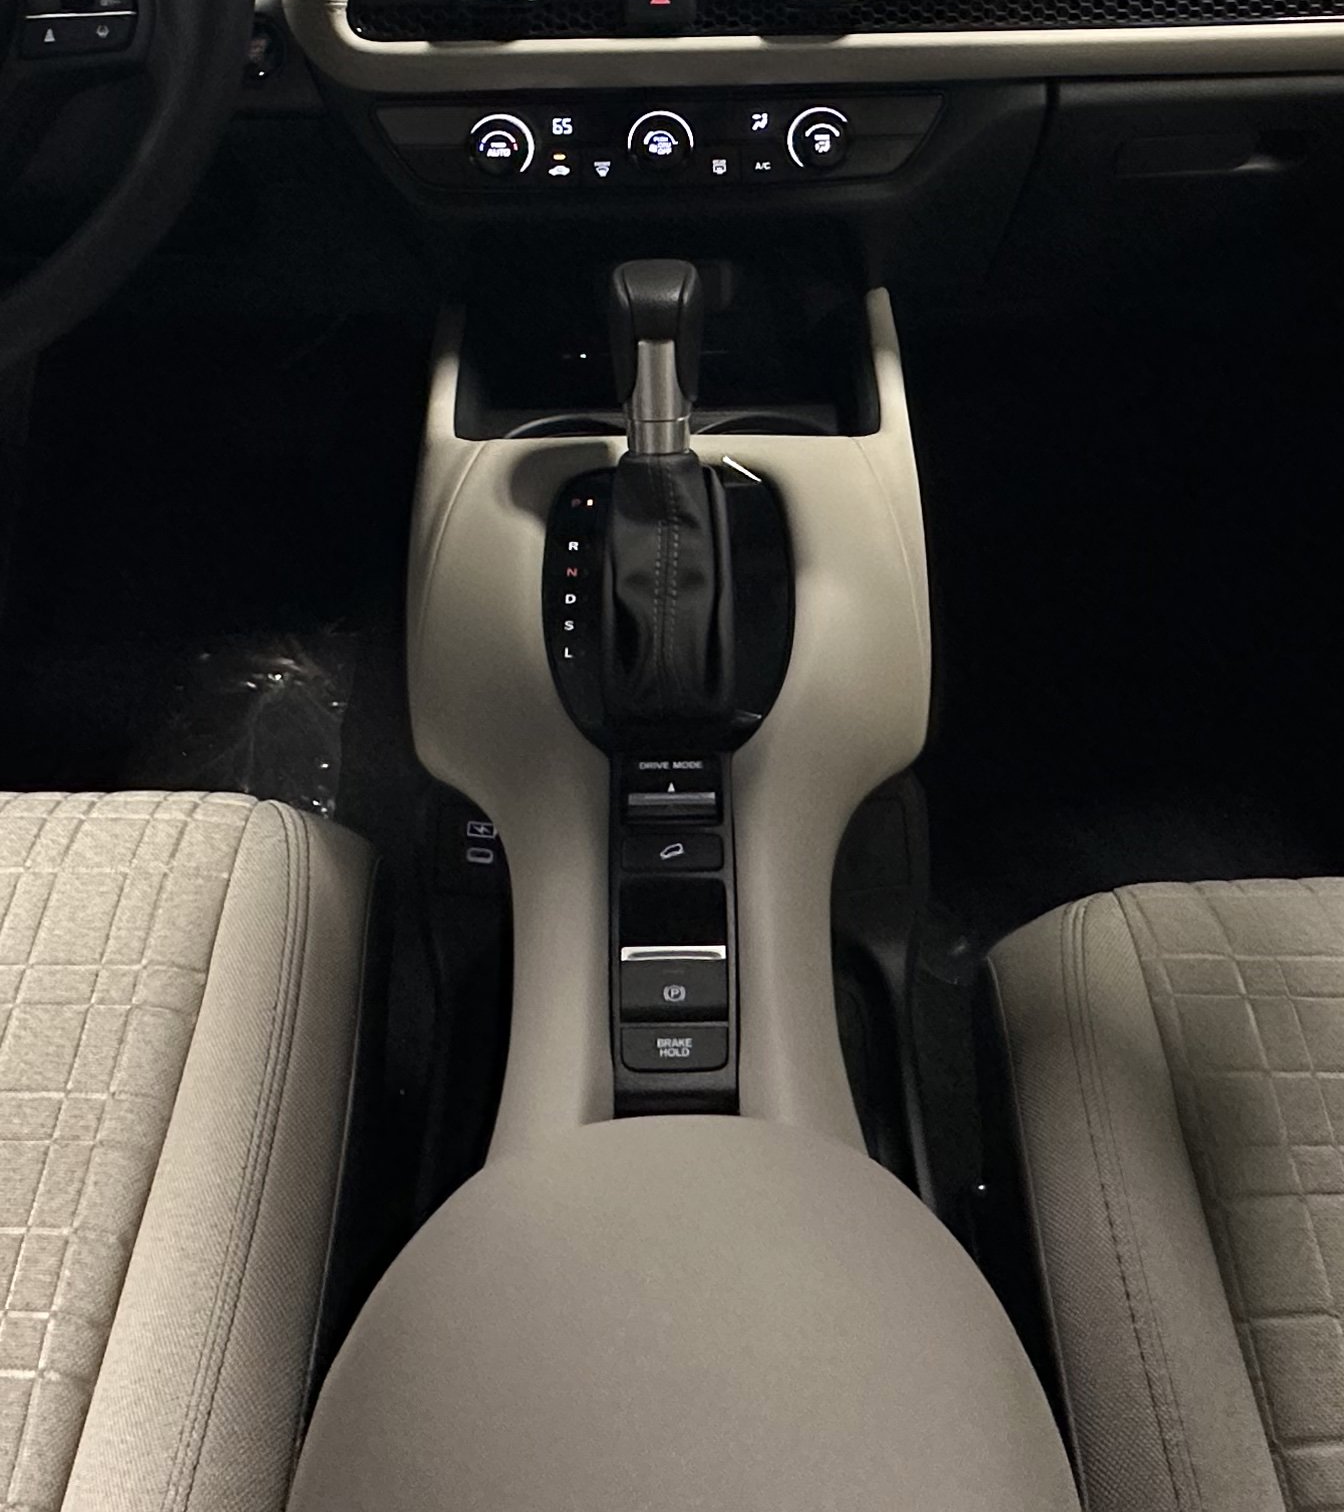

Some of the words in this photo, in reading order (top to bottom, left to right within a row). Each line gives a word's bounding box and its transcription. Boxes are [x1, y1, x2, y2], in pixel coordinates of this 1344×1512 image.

[552, 117, 573, 135] 65
[487, 148, 511, 157] AUTO
[755, 161, 771, 171] A/C
[568, 541, 579, 551] R
[566, 568, 578, 577] N
[565, 594, 577, 604] D
[564, 620, 574, 631] S
[564, 647, 573, 658] L
[639, 761, 669, 770] DRIVE
[672, 760, 703, 769] MODE
[657, 1037, 693, 1048] BRAKE
[659, 1047, 690, 1058] HOLD
